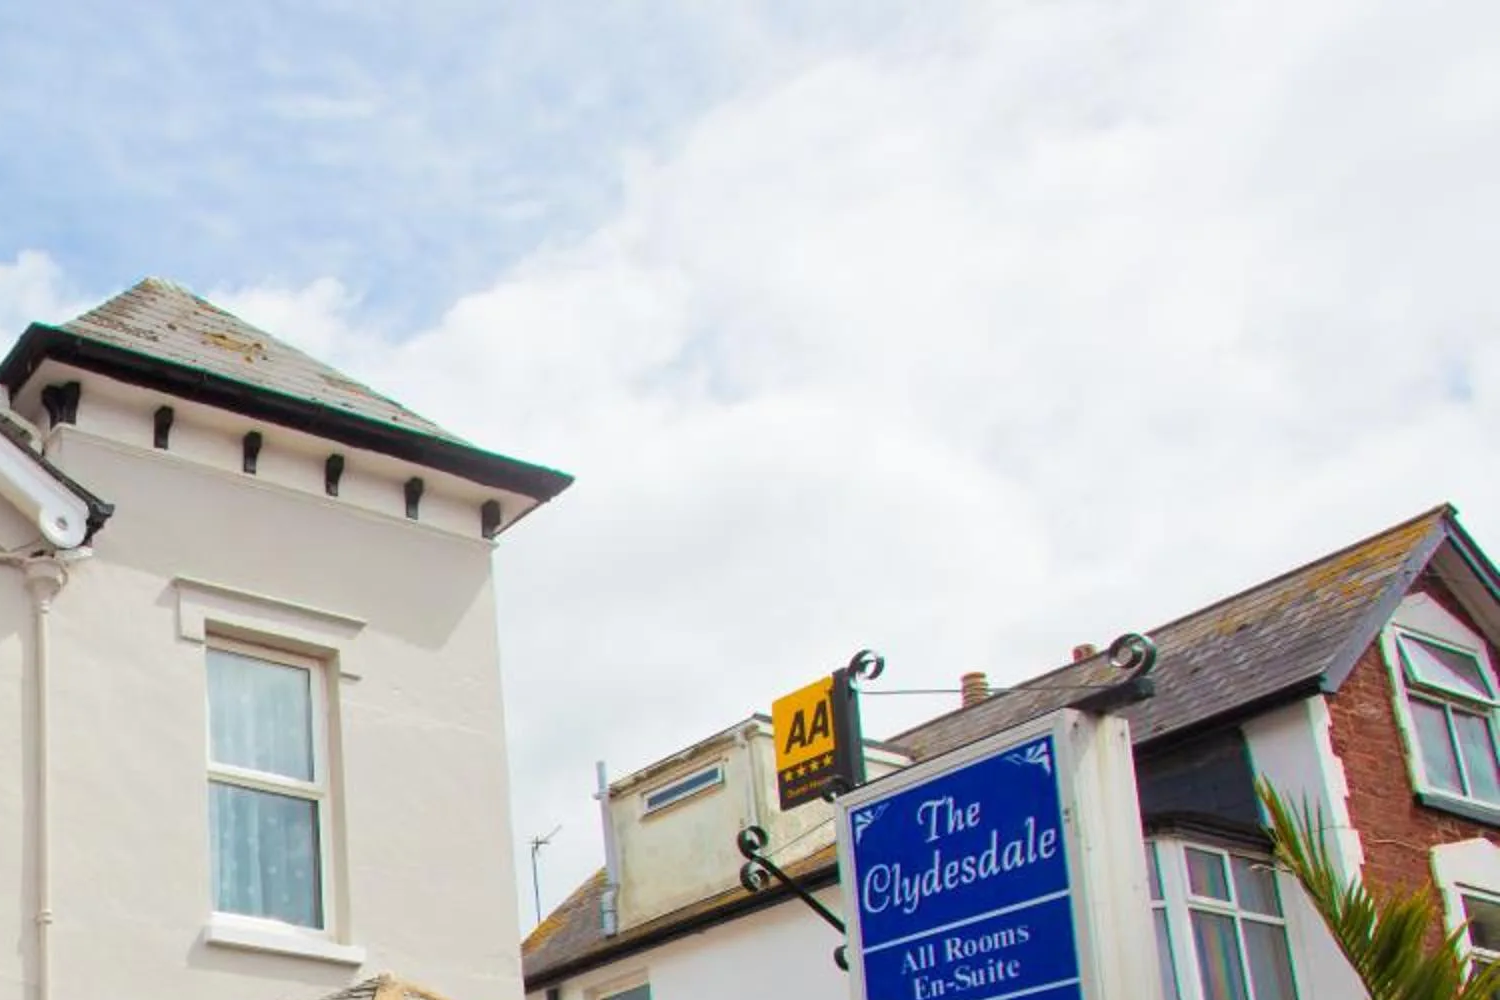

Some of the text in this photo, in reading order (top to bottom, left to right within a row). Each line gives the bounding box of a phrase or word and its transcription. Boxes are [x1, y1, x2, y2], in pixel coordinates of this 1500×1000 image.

[784, 699, 829, 754] AA
[916, 796, 981, 843] The
[863, 817, 1057, 916] Clydesdale
[900, 925, 1030, 976] All Rooms
